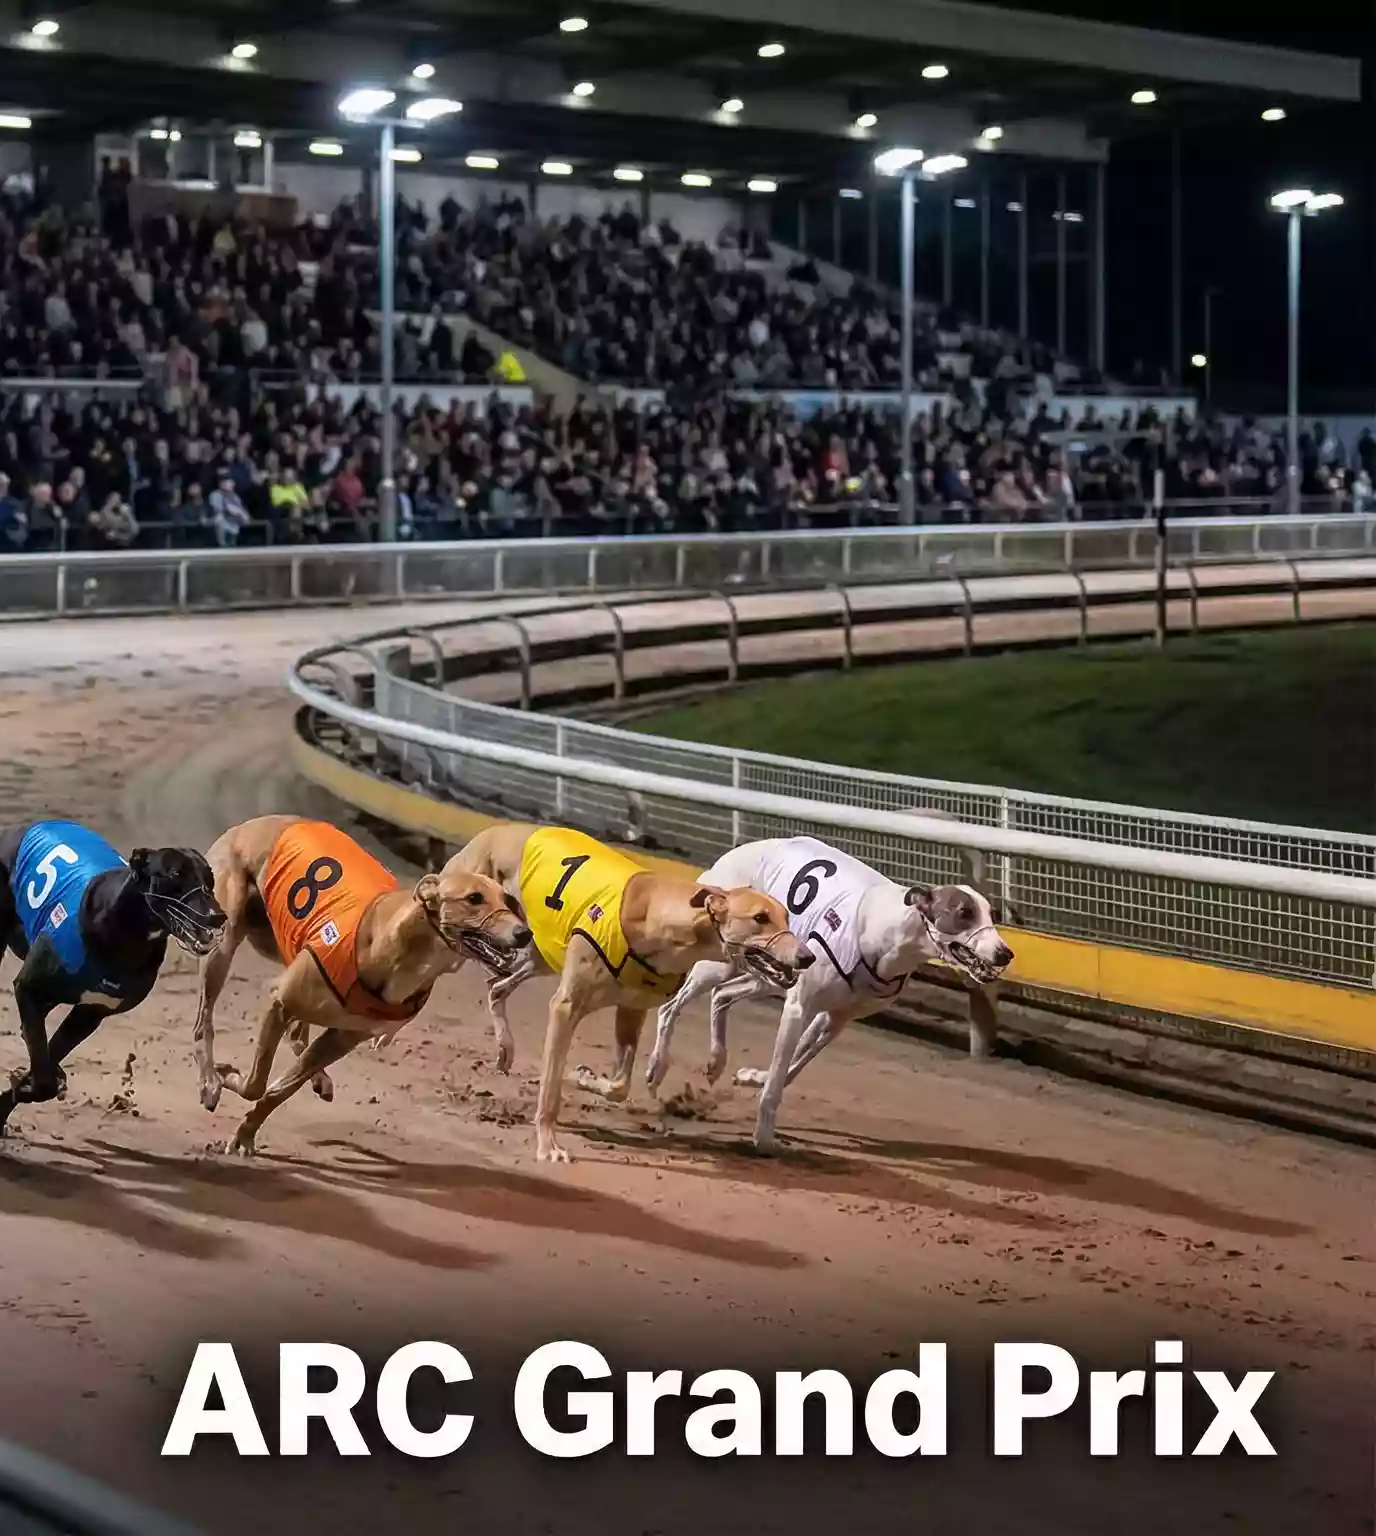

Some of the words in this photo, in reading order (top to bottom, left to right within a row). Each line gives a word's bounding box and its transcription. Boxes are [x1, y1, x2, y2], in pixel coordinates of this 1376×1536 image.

[27, 844, 79, 909] 5
[287, 856, 343, 920] 8
[545, 855, 590, 911] 1
[787, 859, 837, 915] 6
